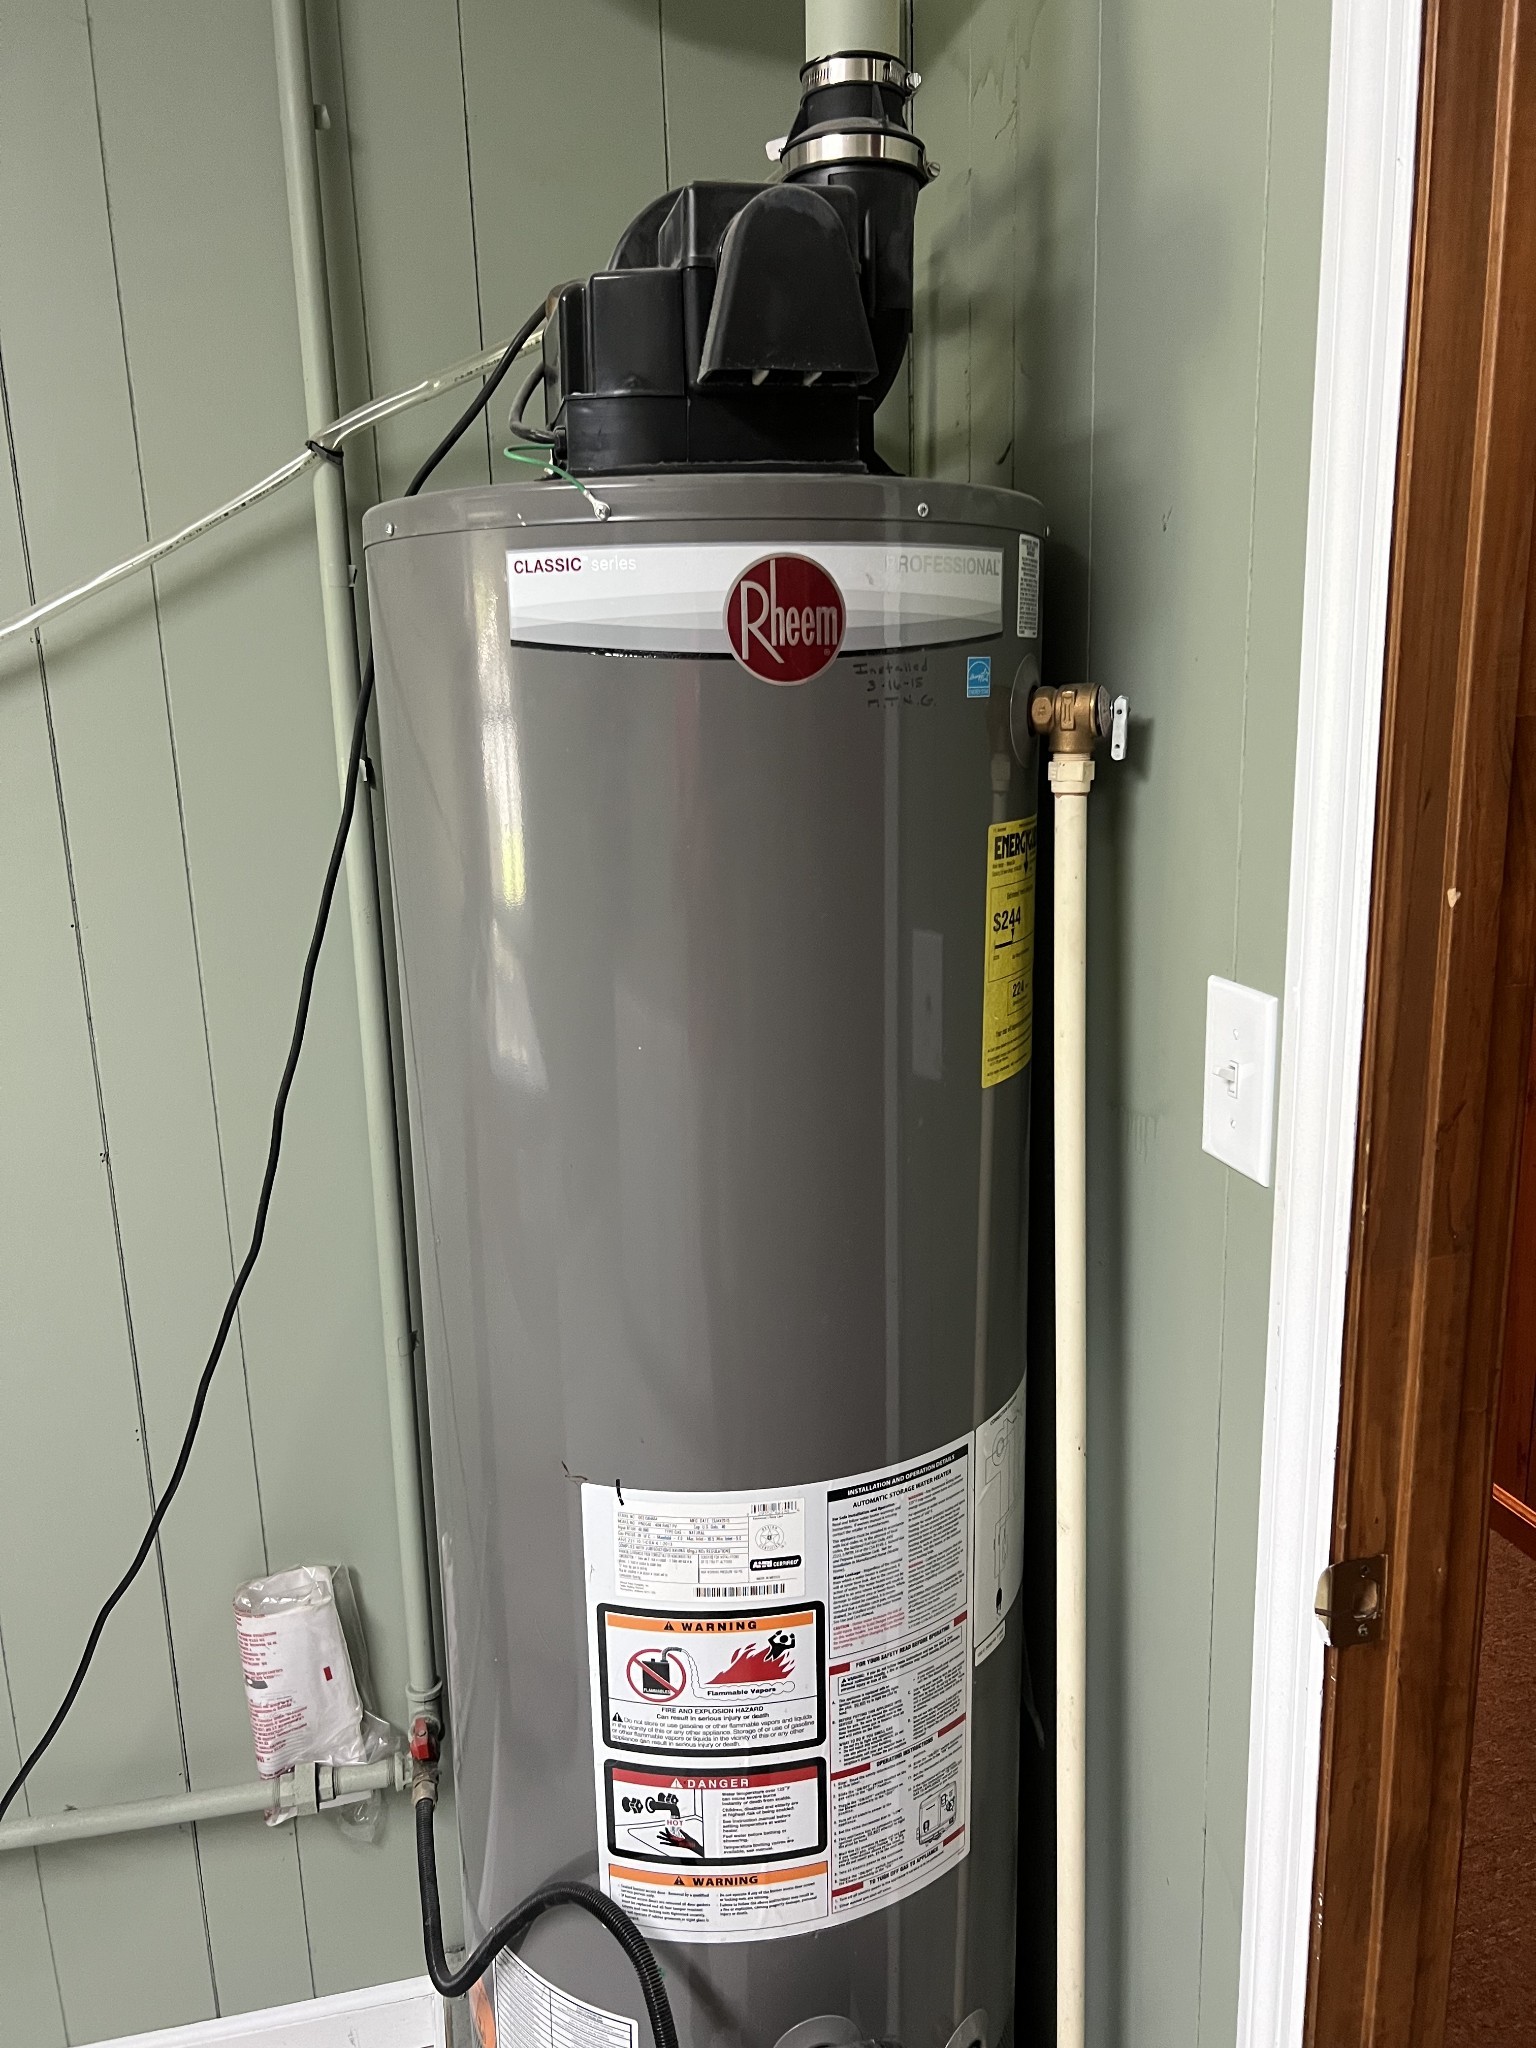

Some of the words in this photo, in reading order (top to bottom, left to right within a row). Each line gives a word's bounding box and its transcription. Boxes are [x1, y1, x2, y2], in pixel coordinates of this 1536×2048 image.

[514, 557, 582, 574] CLASSIC
[590, 554, 637, 572] series
[884, 554, 1000, 576] PROFESSIONAL
[740, 559, 838, 664] Rheem
[853, 656, 928, 675] Installed
[847, 1480, 891, 1496] INSTALLATION
[891, 1475, 905, 1486] AND
[905, 1464, 936, 1479] OPERATION
[935, 1454, 955, 1467] DETAILS
[852, 1495, 889, 1508] AUTOMATIC
[889, 1485, 916, 1497] STORAGE
[915, 1477, 934, 1491] WATER
[933, 1468, 952, 1482] HEATER
[681, 1620, 758, 1632] WARNING
[880, 1649, 899, 1661] SAFETY
[899, 1644, 912, 1653] READ
[707, 1688, 749, 1697] Flammable
[750, 1685, 778, 1695] Vapors
[735, 1706, 764, 1714] HAZARD
[687, 1778, 750, 1789] DANGER
[666, 1818, 685, 1827] HOT
[876, 1873, 890, 1883] TURN
[890, 1868, 900, 1877] OFF
[899, 1863, 909, 1872] GAS
[916, 1846, 939, 1864] APPLIANCE
[692, 1875, 758, 1886] WARNING
